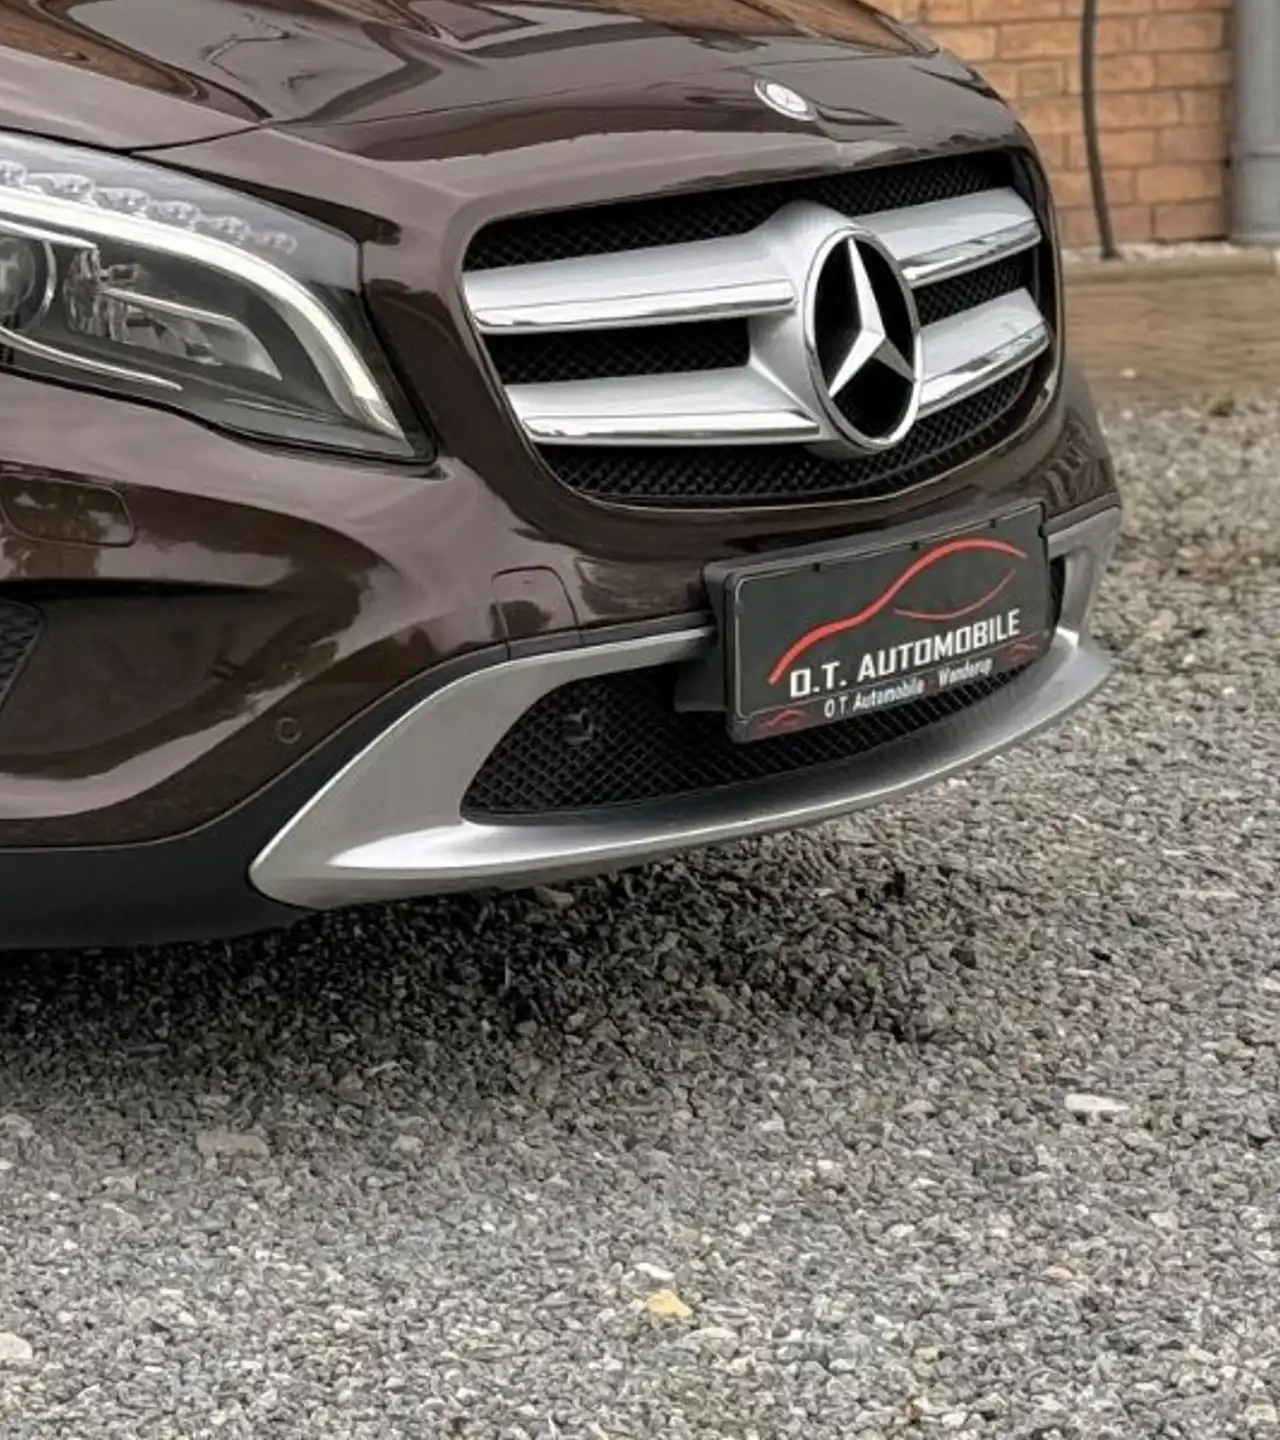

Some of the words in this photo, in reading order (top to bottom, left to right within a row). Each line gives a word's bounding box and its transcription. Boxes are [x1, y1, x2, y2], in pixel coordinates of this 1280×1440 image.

[790, 661, 847, 698] O.T.
[857, 608, 1021, 683] AUTOMOBILE
[852, 677, 925, 712] Automobile
